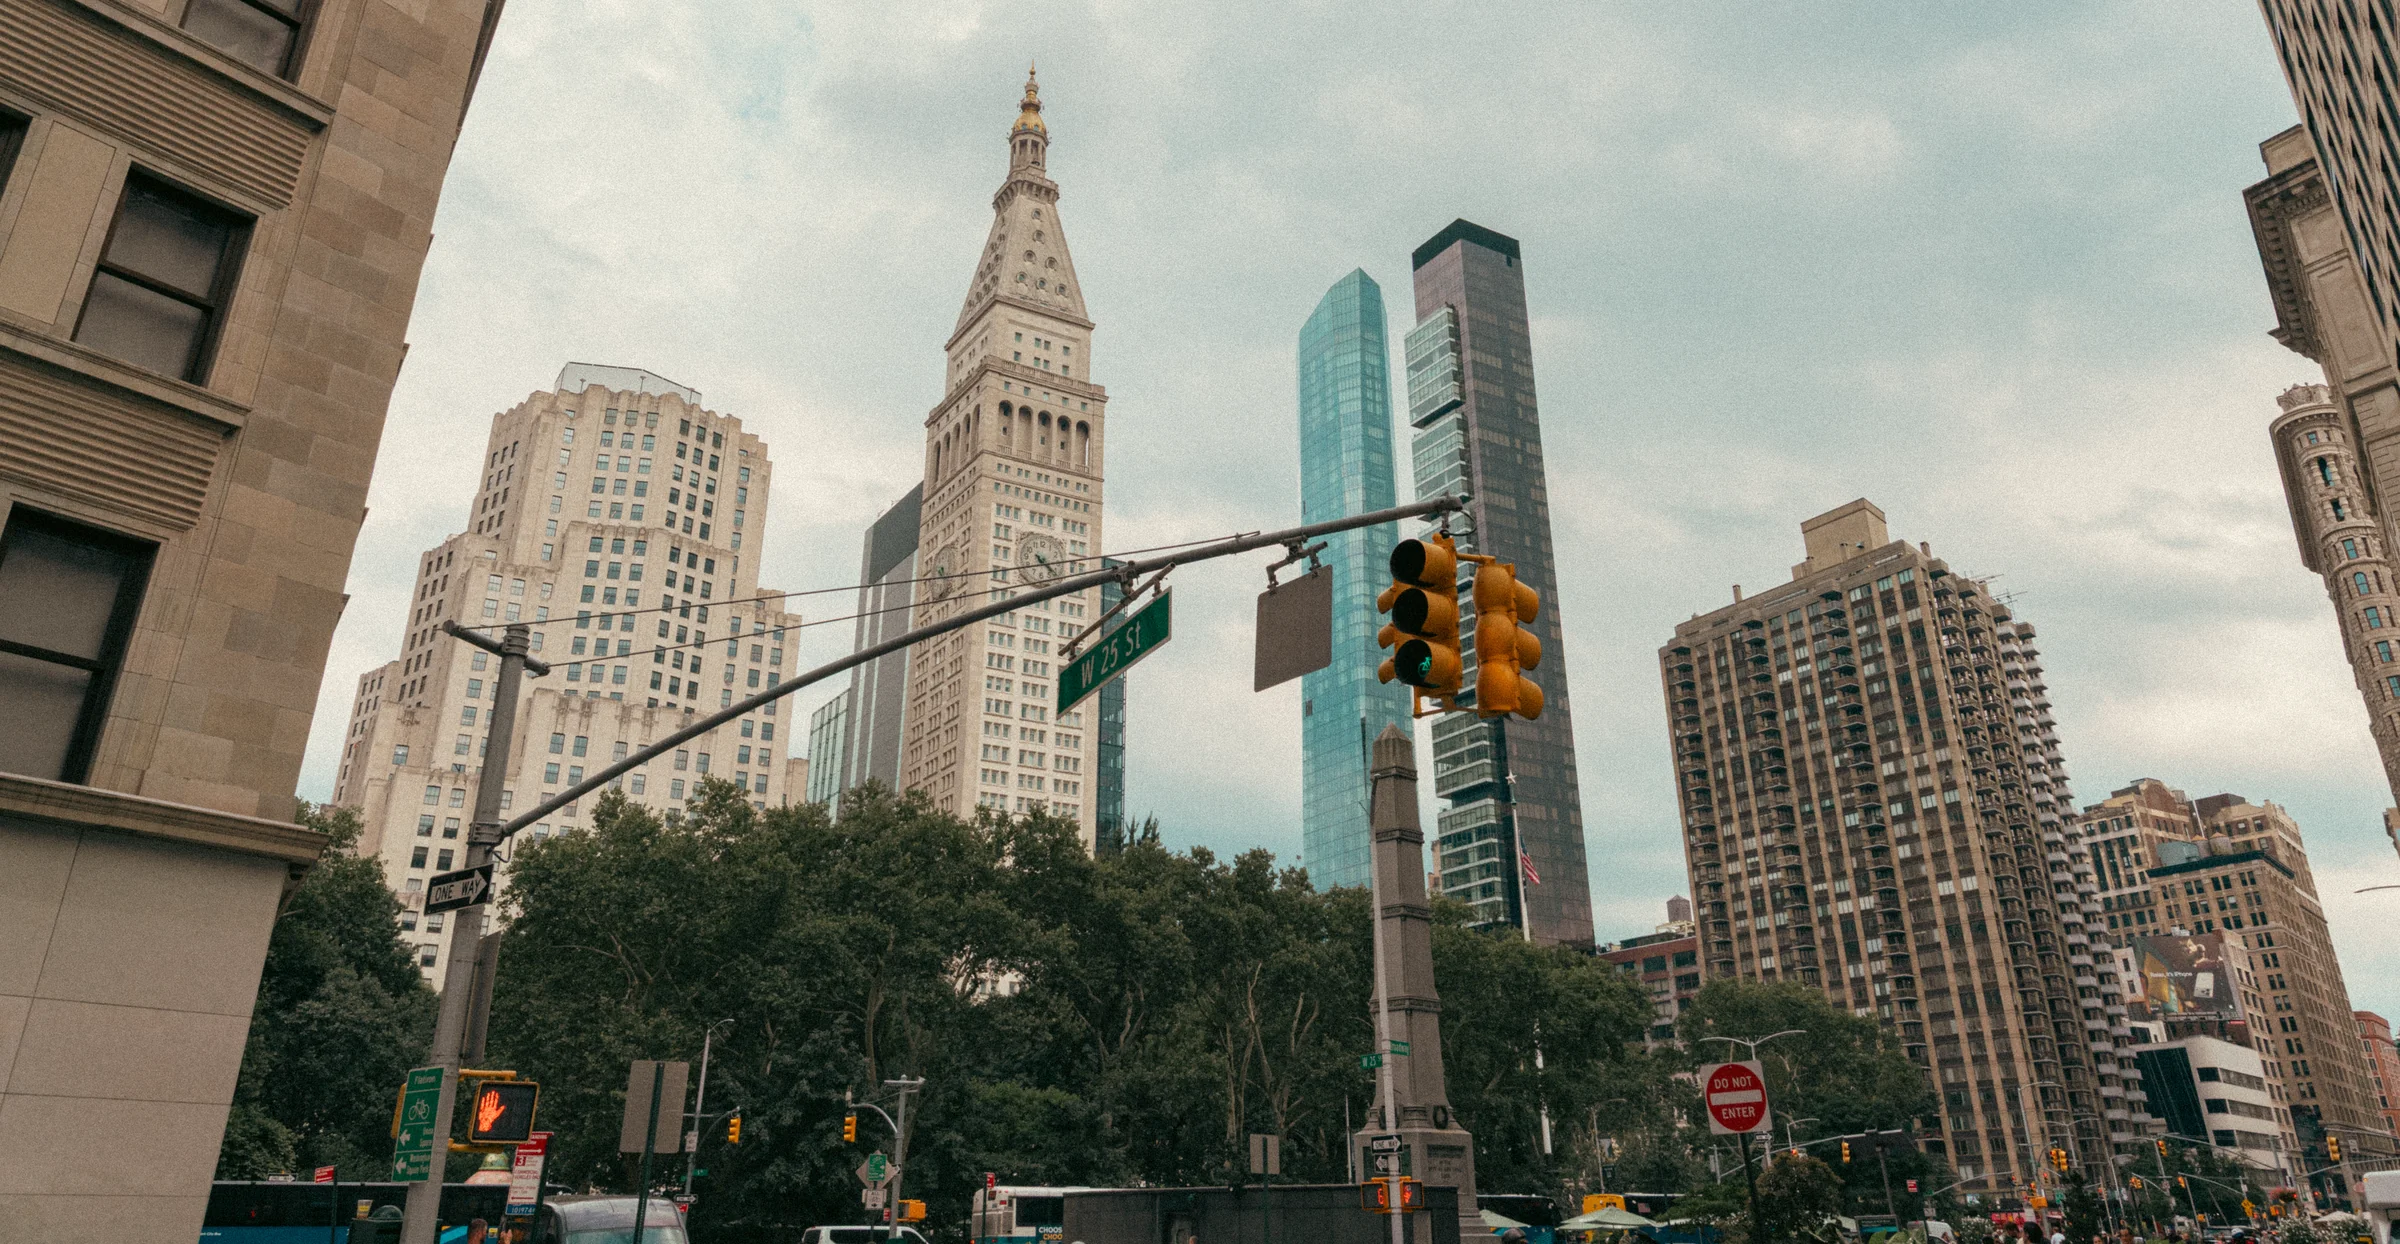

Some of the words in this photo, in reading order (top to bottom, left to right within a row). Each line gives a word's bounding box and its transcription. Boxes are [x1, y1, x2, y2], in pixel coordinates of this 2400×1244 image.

[1081, 656, 1095, 689] W
[1101, 638, 1118, 675] 25
[1126, 621, 1141, 656] St
[435, 884, 455, 902] ONE
[461, 878, 481, 896] WAY
[1390, 1043, 1410, 1055] roadway
[1370, 1055, 1377, 1067] 25
[1714, 1078, 1729, 1090] DO
[1732, 1076, 1753, 1088] NOT
[1721, 1106, 1756, 1119] ENTER
[517, 1156, 525, 1166] 3
